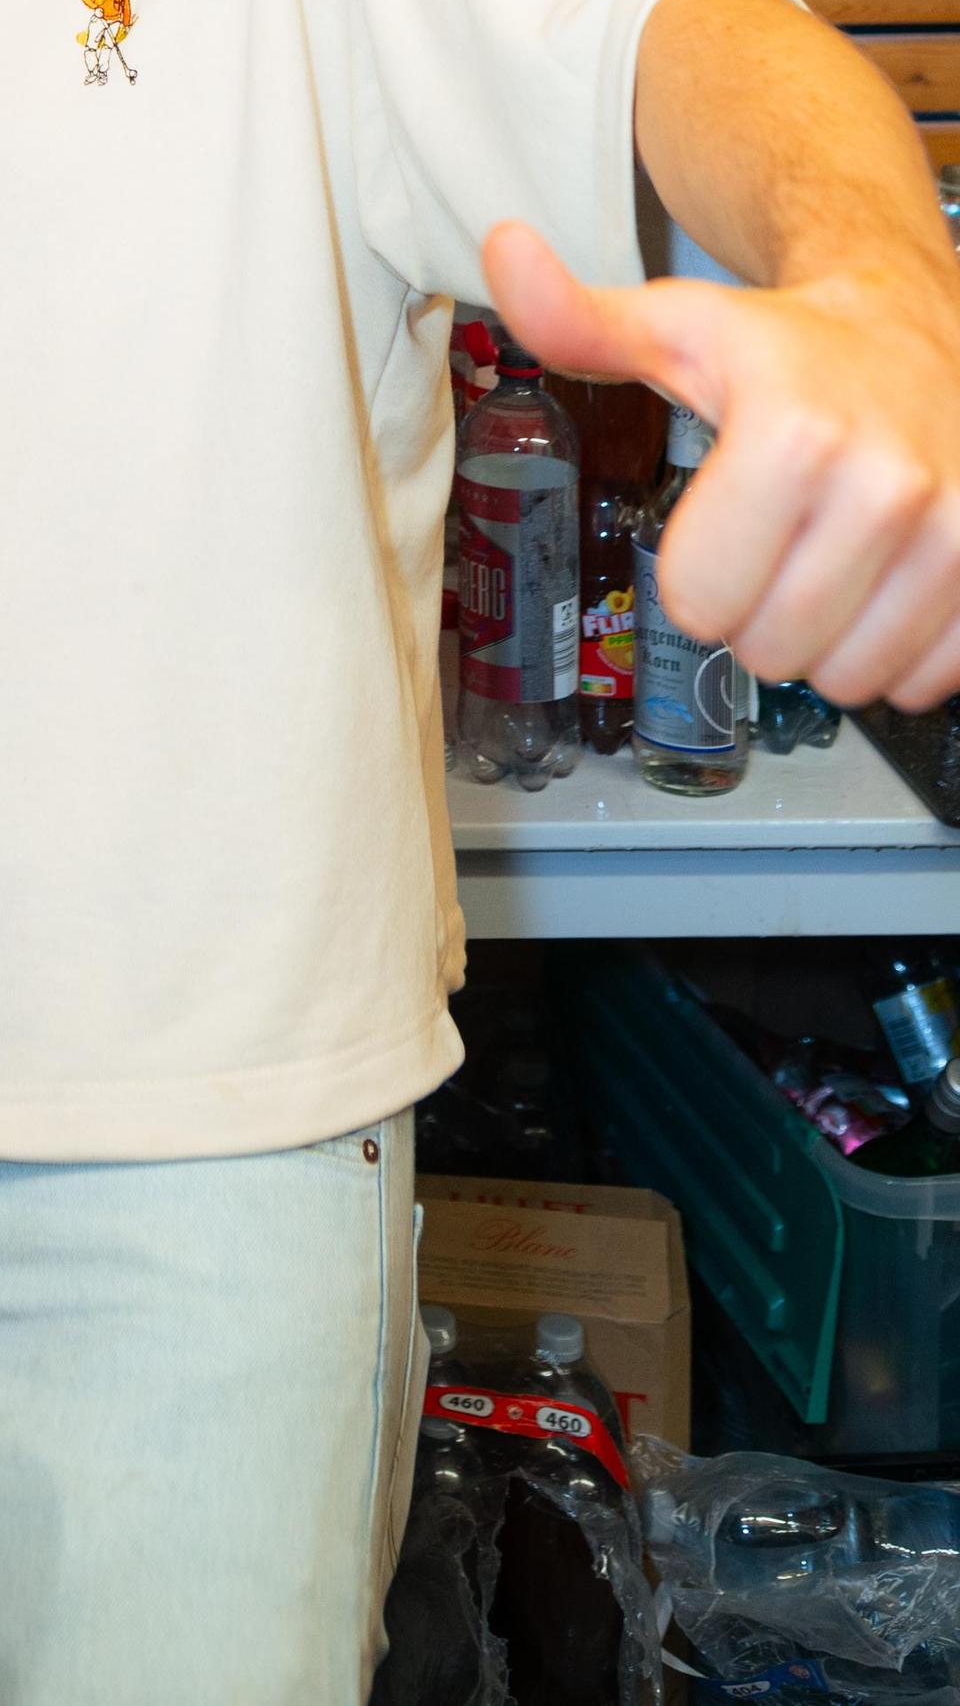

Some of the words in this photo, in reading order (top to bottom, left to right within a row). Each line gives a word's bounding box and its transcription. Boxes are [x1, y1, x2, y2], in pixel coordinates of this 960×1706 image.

[469, 1217, 577, 1261] Blanc
[448, 1395, 486, 1412] 460
[544, 1411, 583, 1434] 460
